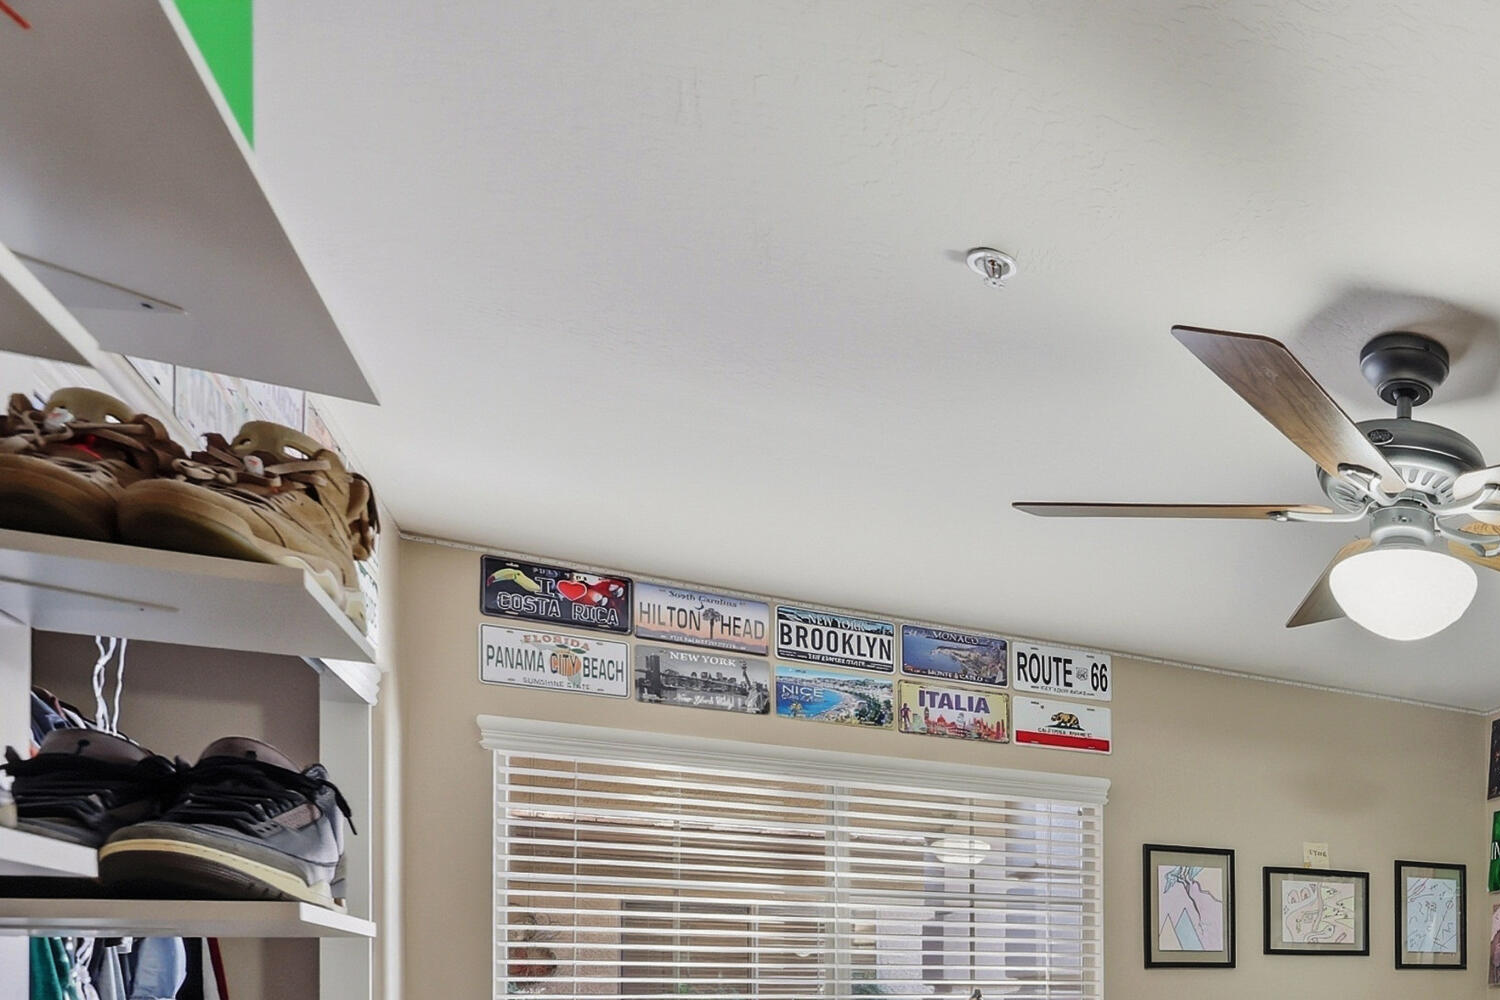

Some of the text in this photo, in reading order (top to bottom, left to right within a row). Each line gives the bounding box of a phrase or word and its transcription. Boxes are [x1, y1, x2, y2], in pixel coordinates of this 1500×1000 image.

[496, 591, 619, 626] COSTA RICA
[669, 590, 737, 608] South Carolina
[639, 601, 765, 640] HILTON HEAD
[522, 634, 591, 652] FLORIDA
[779, 622, 892, 661] BROOKLYN
[932, 631, 979, 645] MONACO
[486, 644, 625, 683] PANAMA CITY BEACH
[670, 651, 737, 667] NEW YORK
[1017, 651, 1108, 692] ROUTE 66
[782, 685, 825, 698] NICE
[918, 689, 991, 714] ITALIA
